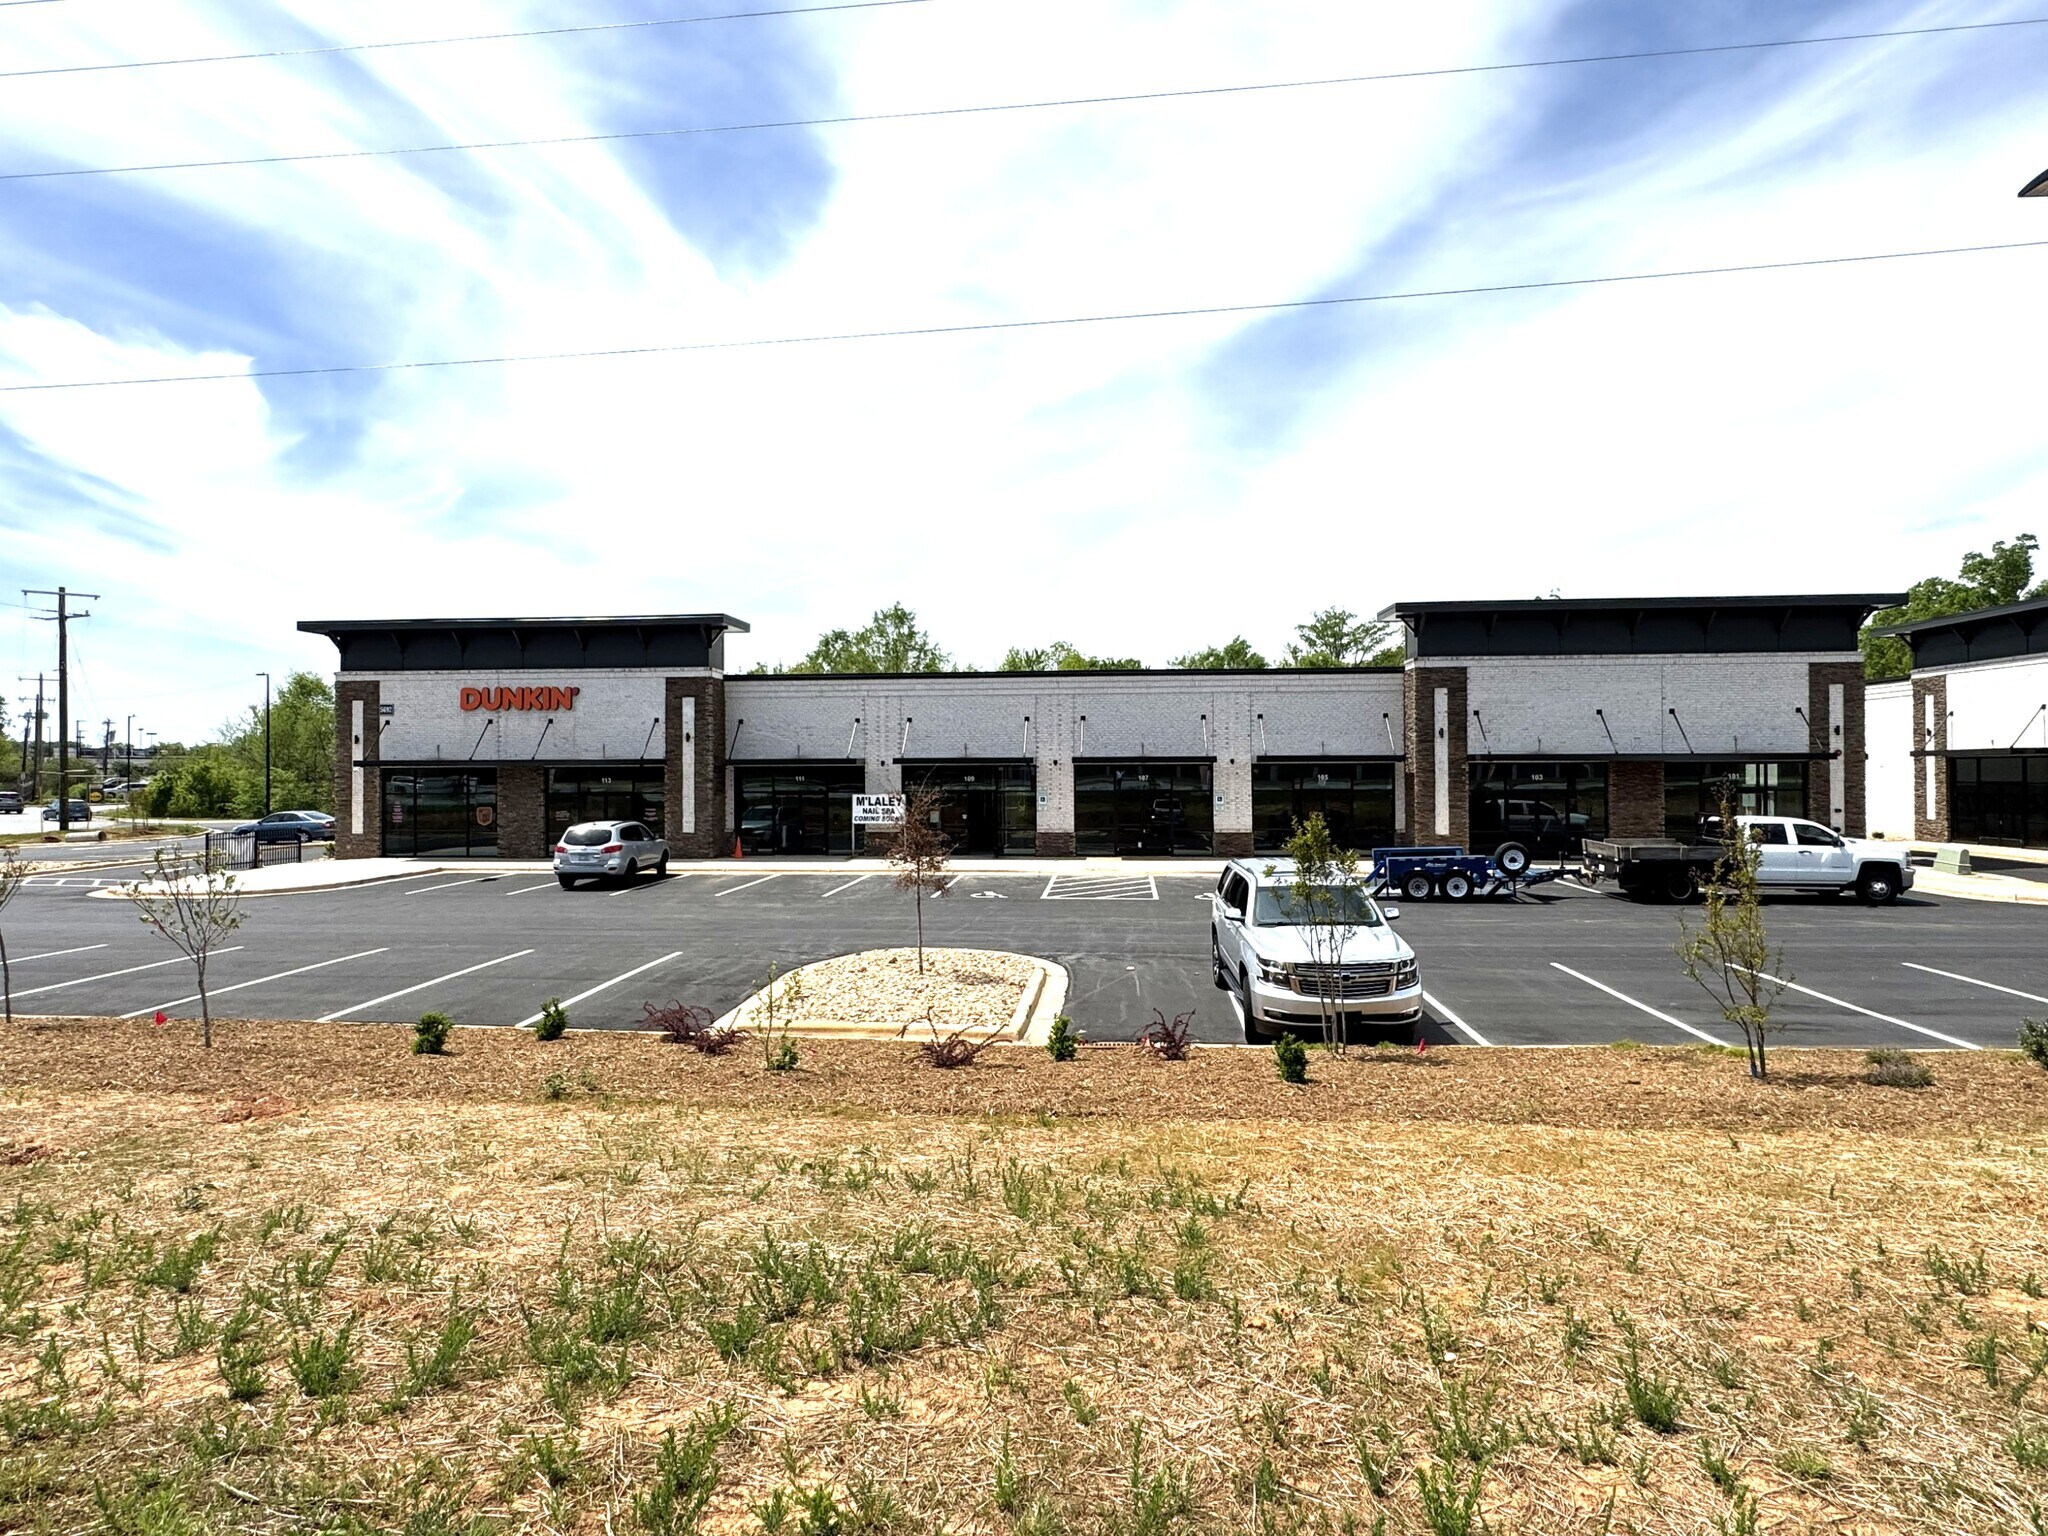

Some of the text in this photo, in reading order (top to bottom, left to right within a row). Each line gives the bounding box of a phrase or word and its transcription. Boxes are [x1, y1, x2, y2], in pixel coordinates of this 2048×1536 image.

[460, 686, 580, 711] DUNKIN'
[856, 796, 902, 807] M'LALEY
[862, 807, 895, 815] NAIL SPA
